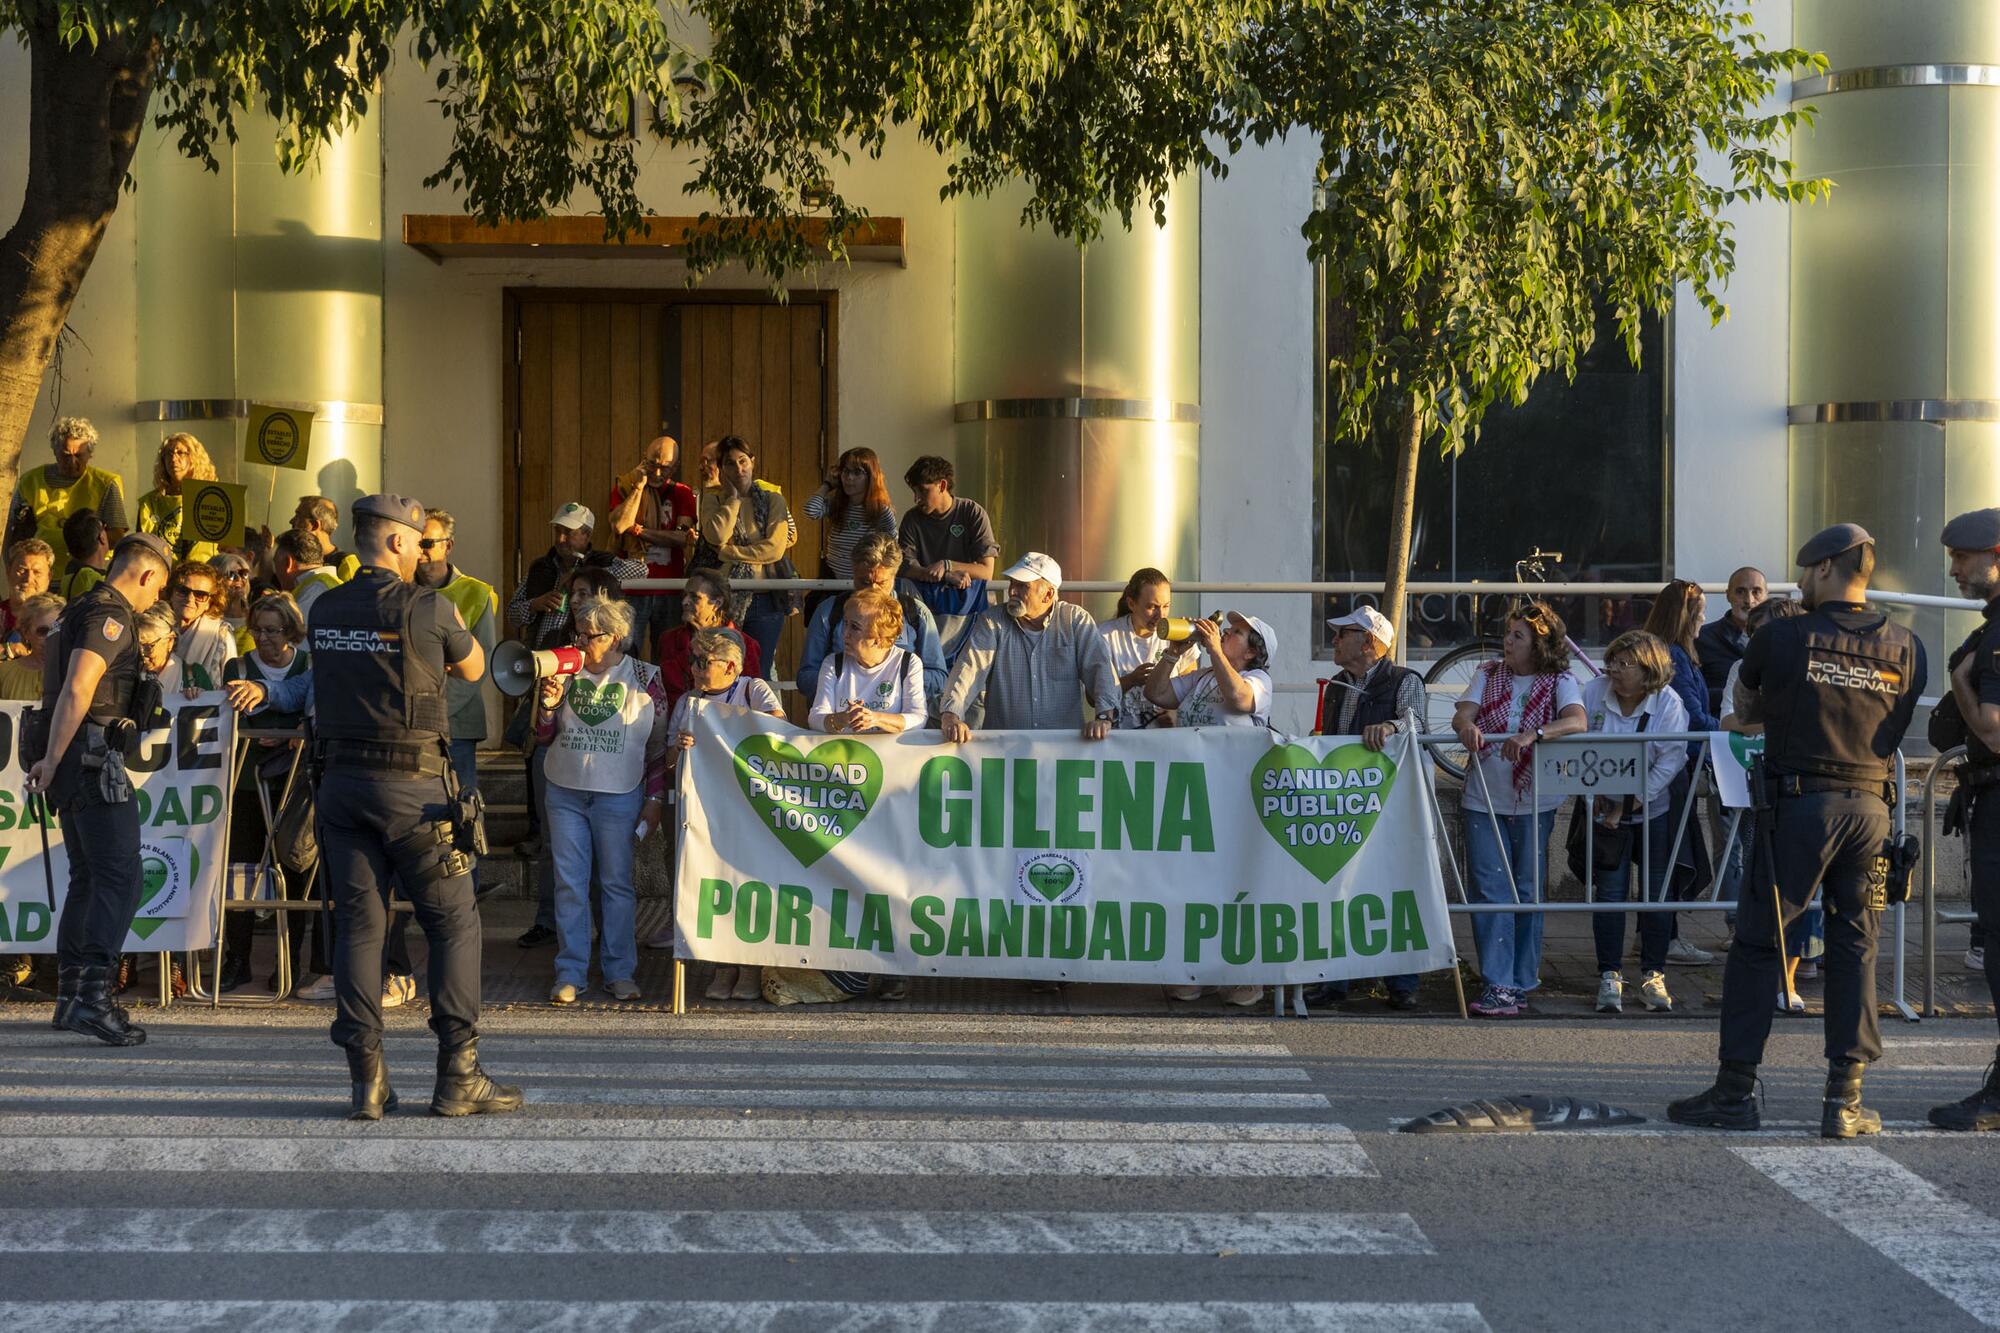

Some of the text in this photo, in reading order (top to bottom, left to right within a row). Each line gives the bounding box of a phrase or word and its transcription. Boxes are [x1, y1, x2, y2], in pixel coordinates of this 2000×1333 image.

[314, 640, 400, 652] NACIONAL
[1806, 671, 1899, 695] NACIONAL
[577, 706, 612, 717] 100%
[577, 727, 620, 738] SANIDAD
[747, 753, 868, 786] SANIDAD
[1262, 767, 1383, 790] SANIDAD
[749, 776, 866, 812] PÚBLICA
[918, 755, 1216, 852] GILENA
[1262, 789, 1382, 818] PÚBLICA
[770, 807, 844, 838] 100%
[1285, 820, 1363, 846] 100%
[696, 877, 1429, 966] POR LA SANIDAD PÚBLICA
